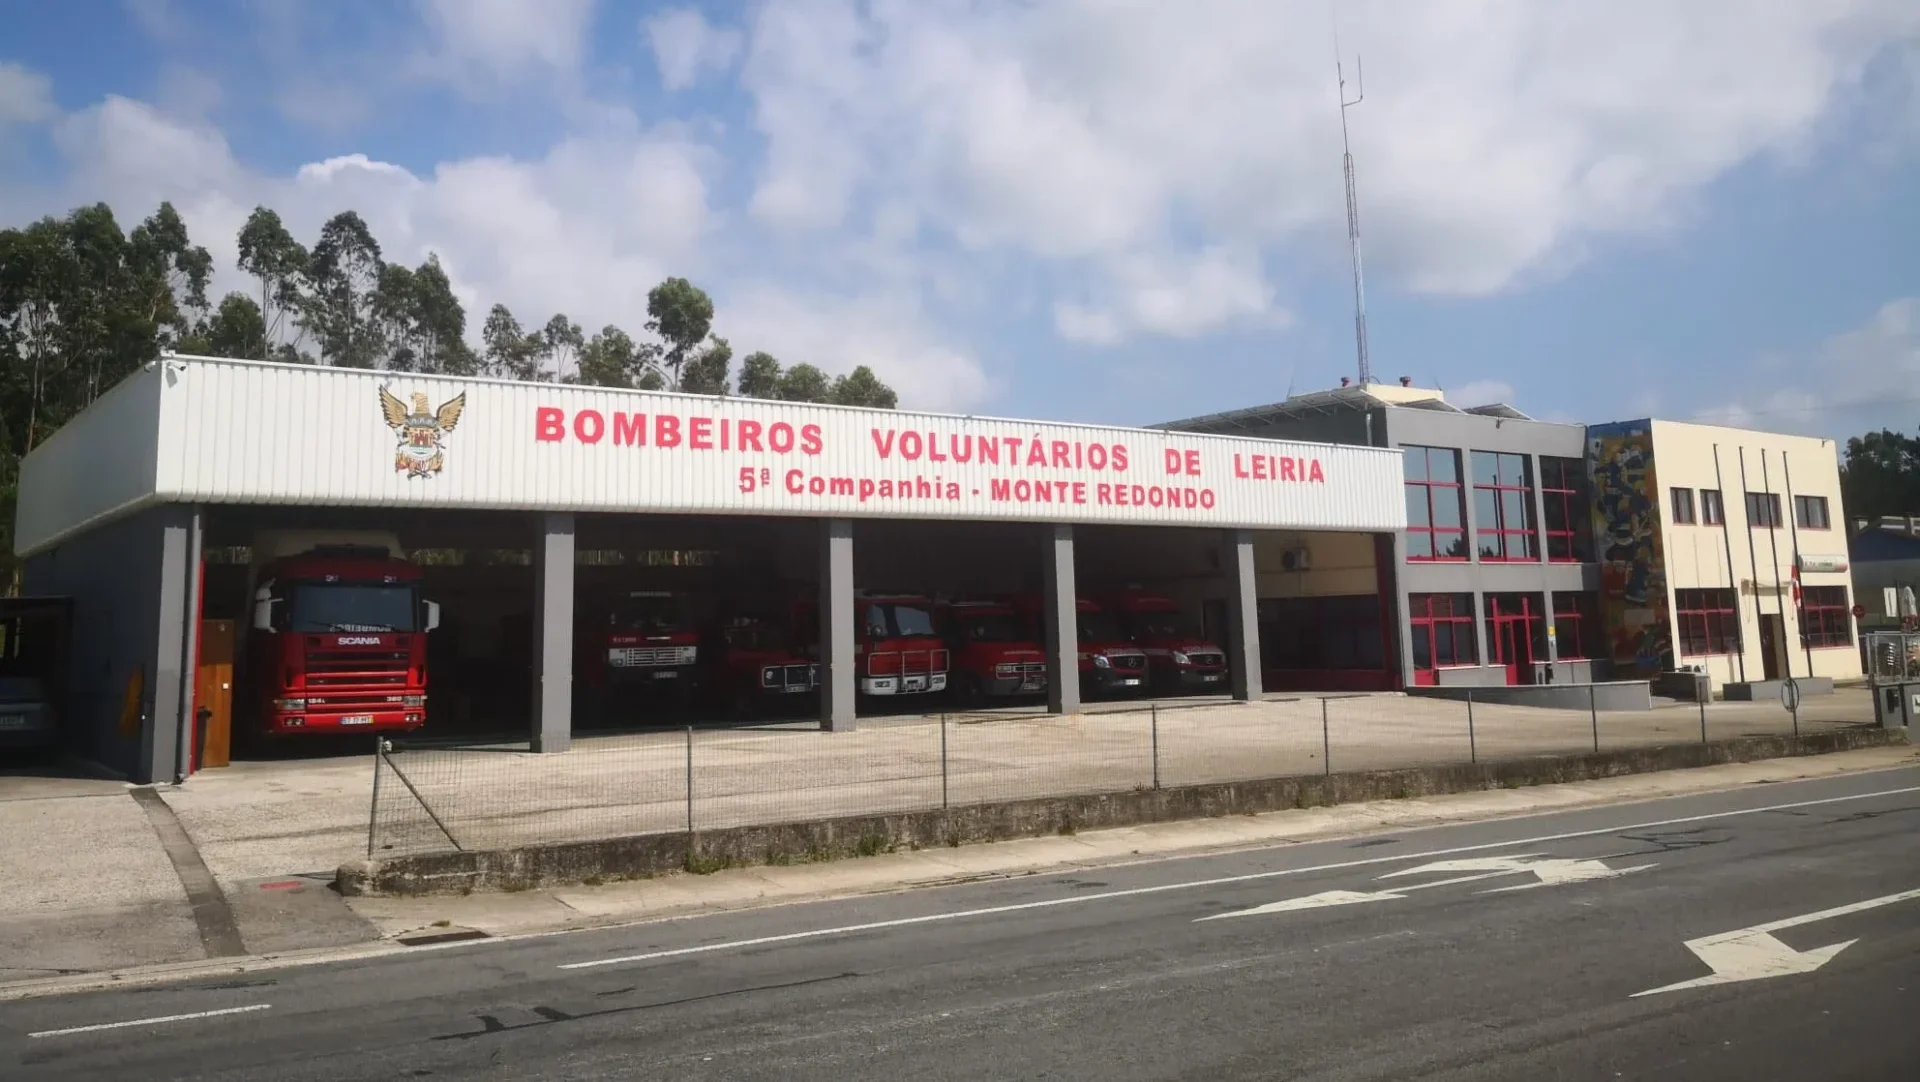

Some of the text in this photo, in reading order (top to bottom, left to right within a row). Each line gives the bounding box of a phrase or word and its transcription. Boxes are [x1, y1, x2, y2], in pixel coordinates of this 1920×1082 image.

[536, 406, 1326, 483] BOMBEIROS VOLUNTÁRIOS DE LEIRIA
[739, 466, 771, 493] 5ª
[785, 468, 961, 503] Companhia
[990, 478, 1086, 505] MONTE
[1097, 482, 1215, 510] REDONDO
[337, 636, 381, 646] SCANIA
